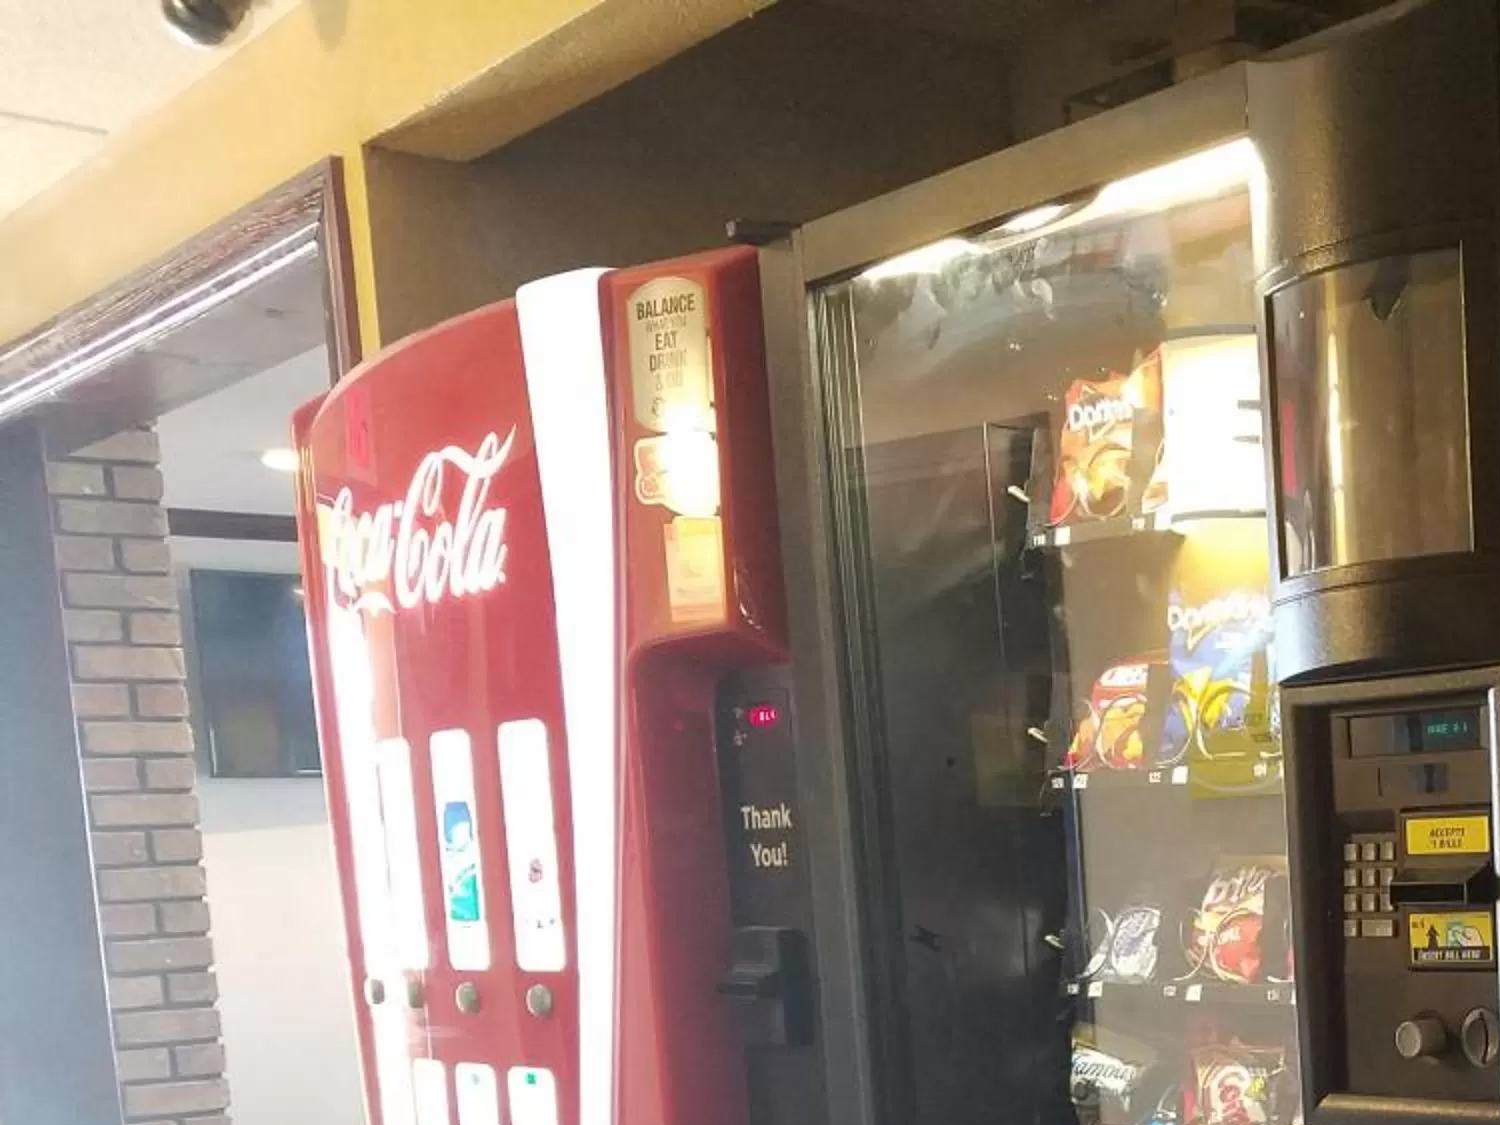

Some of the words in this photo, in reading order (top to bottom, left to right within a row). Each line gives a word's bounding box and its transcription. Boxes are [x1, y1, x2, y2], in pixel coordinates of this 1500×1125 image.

[635, 293, 697, 321] BALANCE
[655, 330, 677, 351] EAT
[740, 802, 793, 830] Thank
[750, 842, 788, 868] You!
